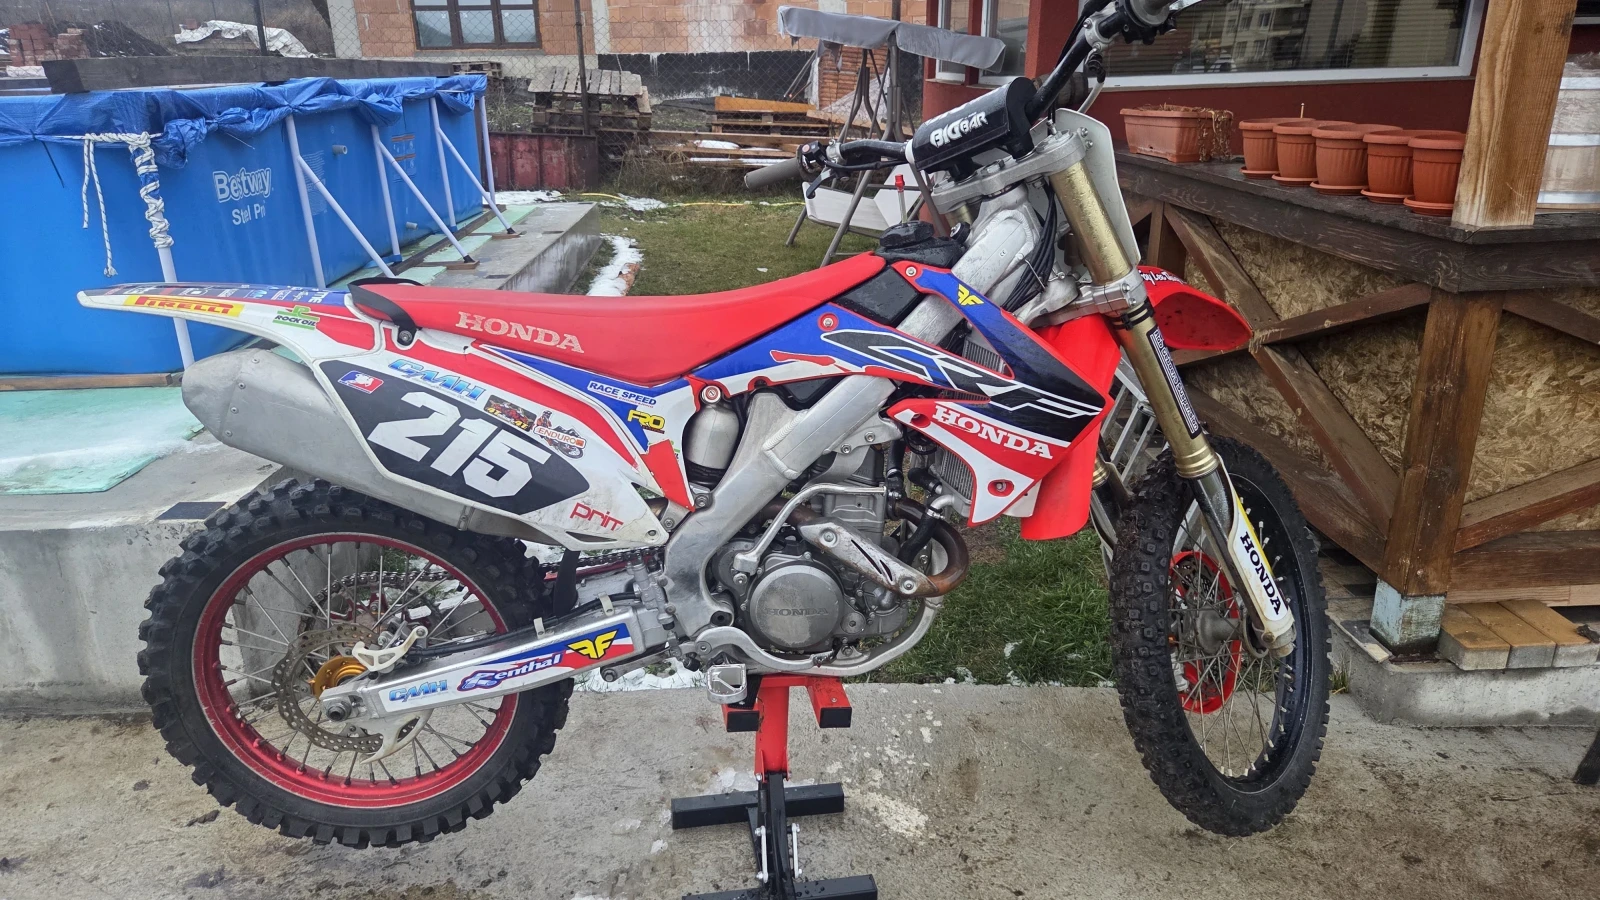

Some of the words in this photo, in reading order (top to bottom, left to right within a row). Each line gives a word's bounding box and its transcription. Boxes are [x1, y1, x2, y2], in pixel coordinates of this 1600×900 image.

[213, 167, 271, 203] Bestway
[134, 296, 234, 314] PIRELLI
[275, 314, 301, 323] ROCK
[455, 311, 585, 354] HONDA
[589, 382, 620, 396] RACE
[621, 390, 657, 406] SPEED
[367, 391, 552, 498] 215
[932, 405, 1053, 459] HONDA
[1239, 531, 1283, 615] HONDA
[765, 607, 829, 617] HONDA
[460, 653, 562, 690] Renthal
